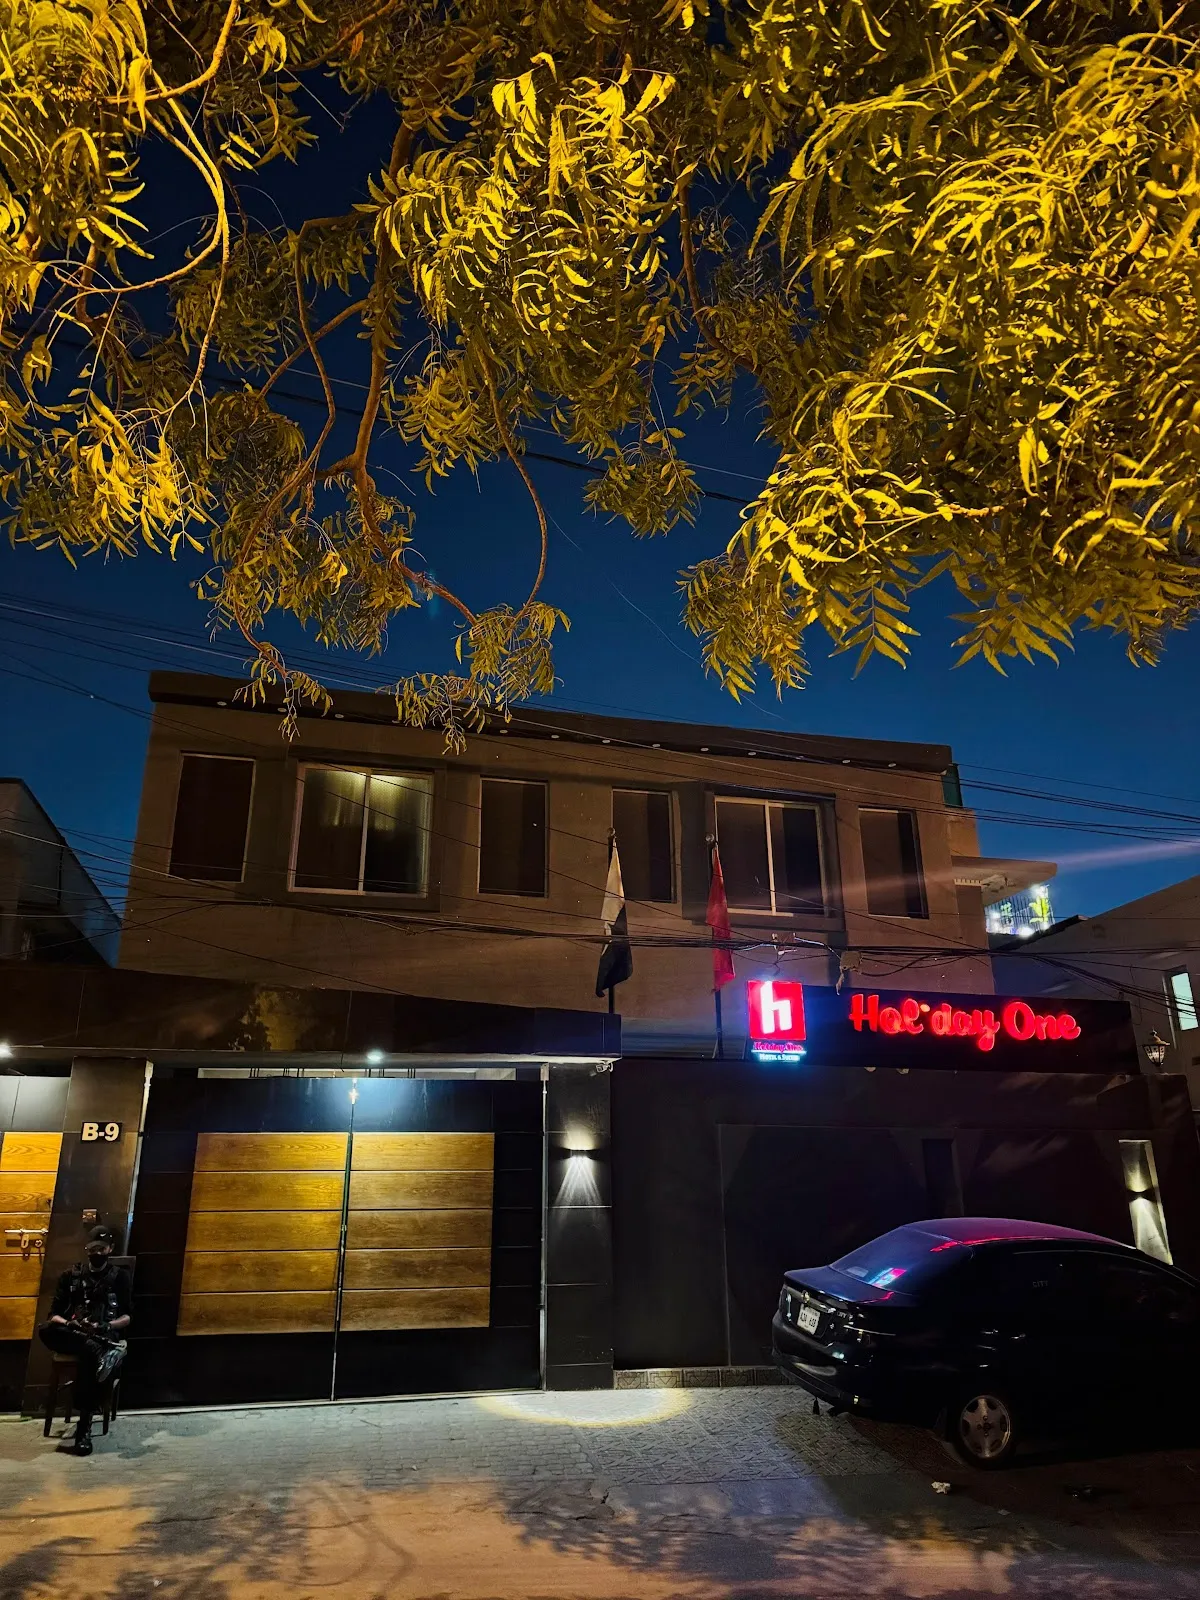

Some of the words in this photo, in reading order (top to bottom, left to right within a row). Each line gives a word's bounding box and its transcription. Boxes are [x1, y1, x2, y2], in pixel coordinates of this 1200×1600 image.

[760, 980, 792, 1034] h
[848, 994, 1000, 1051] Holday
[1003, 1000, 1081, 1040] One
[82, 1122, 119, 1141] B-9
